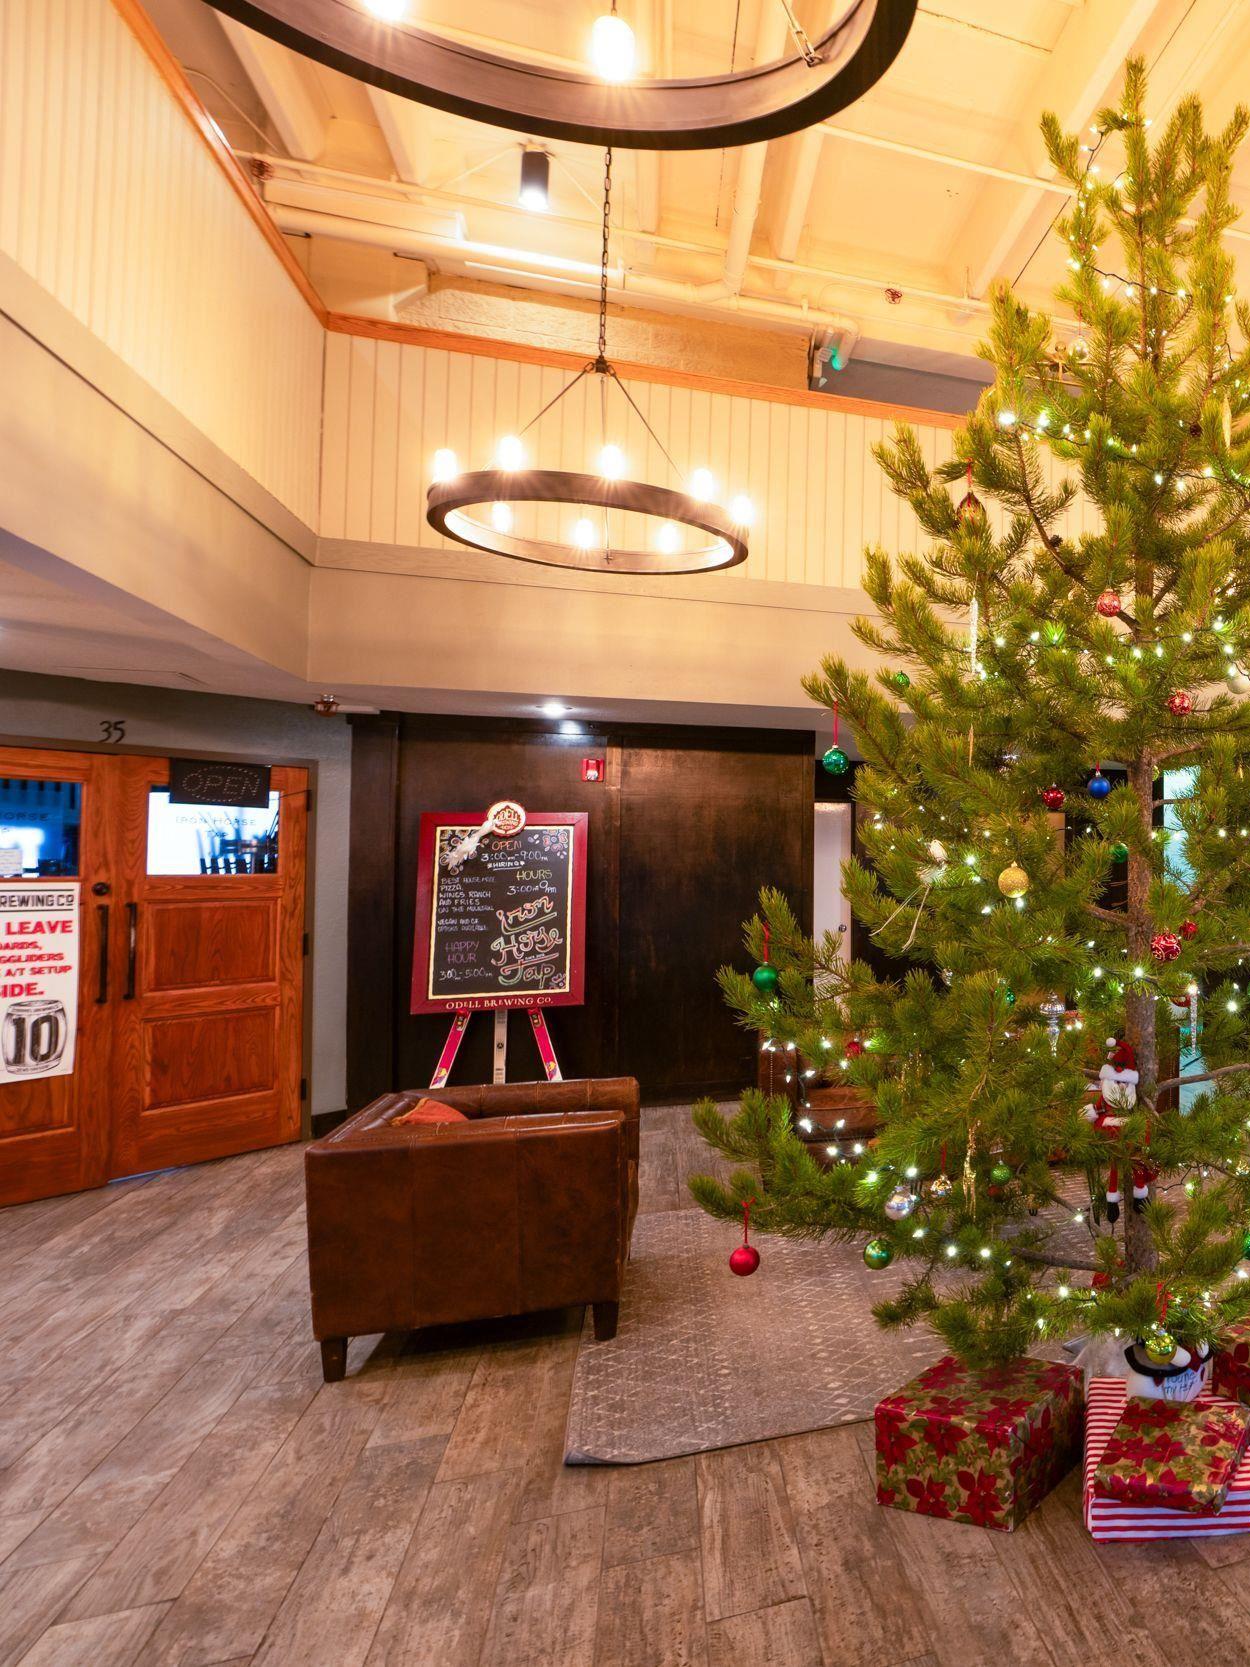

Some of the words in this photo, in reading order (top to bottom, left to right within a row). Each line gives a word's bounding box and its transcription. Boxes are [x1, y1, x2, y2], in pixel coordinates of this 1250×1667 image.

[99, 720, 125, 744] 35
[182, 772, 259, 796] OPEN
[214, 817, 257, 827] HORSE
[491, 840, 522, 850] OPEN
[516, 869, 552, 880] HOURS
[6, 920, 73, 935] LEAVE
[445, 941, 479, 953] HAPPY
[490, 926, 564, 967] Horse
[448, 953, 477, 964] HOUR
[5, 968, 25, 977] A/T
[30, 965, 73, 975] SETUP
[498, 952, 559, 989] Tap
[446, 1001, 481, 1010] ODELL
[484, 998, 534, 1008] BREWING
[12, 1014, 59, 1066] 10
